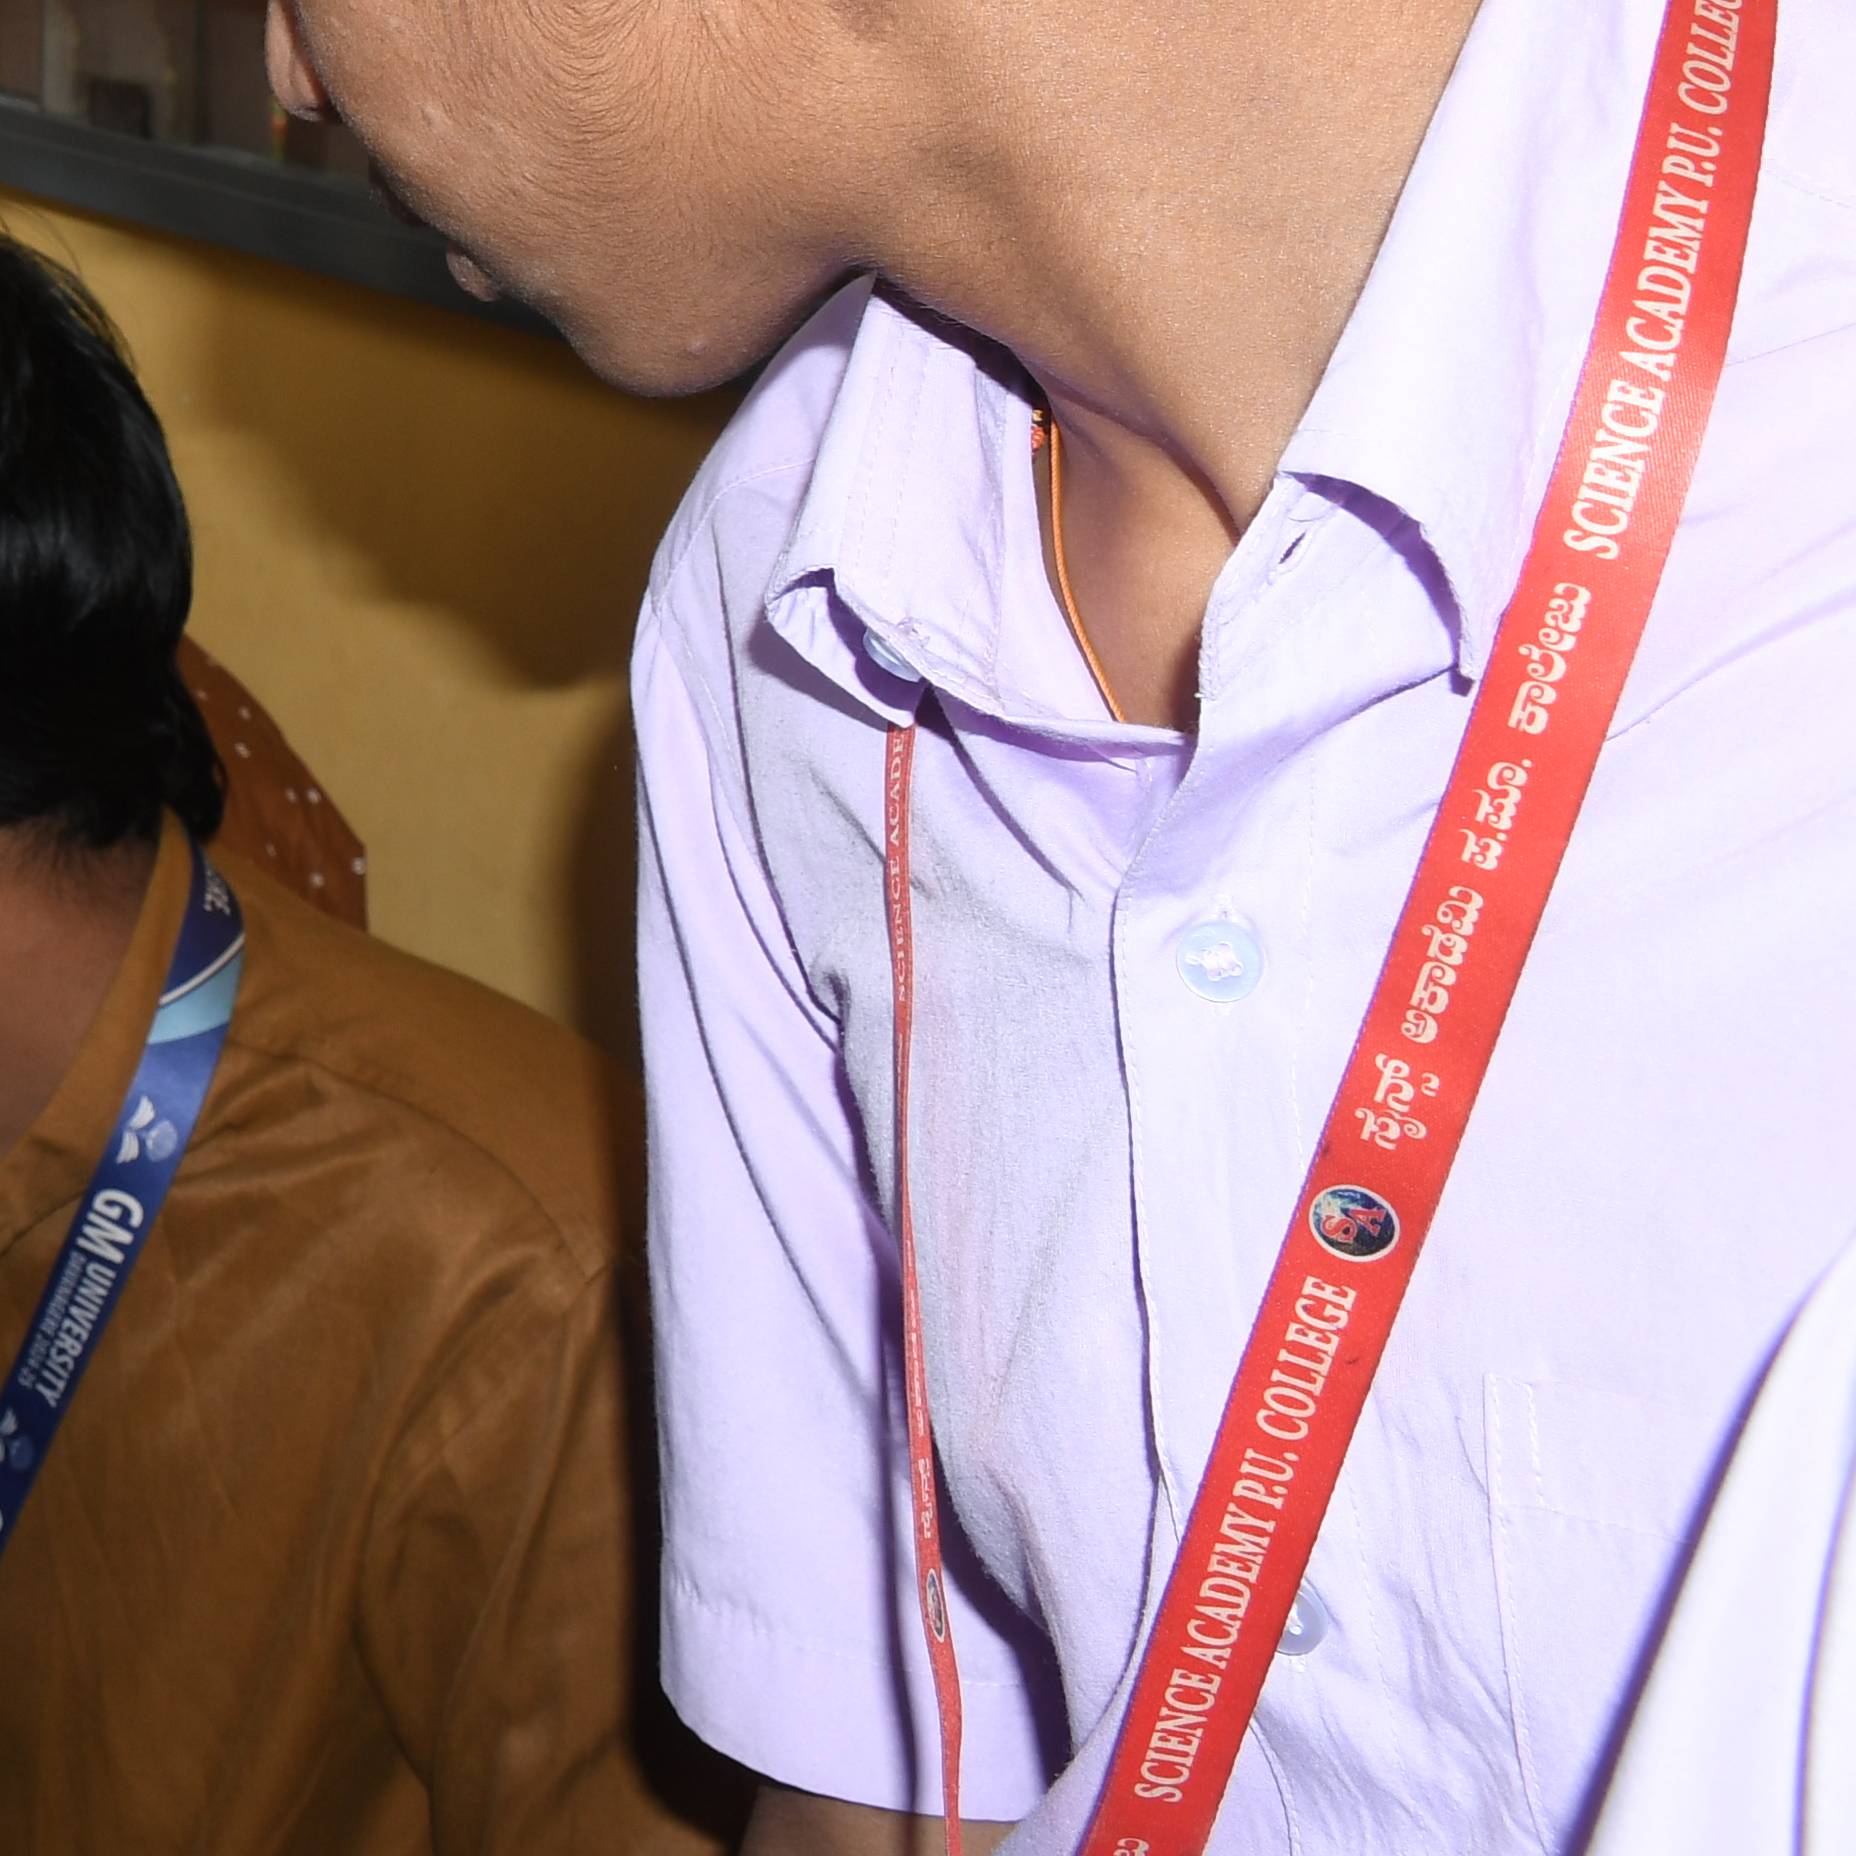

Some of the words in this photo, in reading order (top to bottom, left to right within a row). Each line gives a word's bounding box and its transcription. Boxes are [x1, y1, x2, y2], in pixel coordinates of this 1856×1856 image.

[1661, 123, 1724, 189] P.U.
[1625, 185, 1710, 383] ACADEMY
[1563, 376, 1664, 561] SCIENCE
[888, 728, 905, 845] ACADE
[1399, 884, 1485, 1045] ಅಕಾಡೆಮಿ
[1506, 581, 1592, 736] ಕಾಲೇಜು
[889, 855, 905, 1002] SCIENCE
[74, 1187, 145, 1265] GM
[34, 1260, 118, 1409] UNIVERSITY
[1255, 1273, 1357, 1443] COLLEGE
[1238, 1446, 1300, 1511] P.U.
[1185, 1499, 1277, 1663] ACADEMY
[1134, 1663, 1222, 1804] SCIENCE
